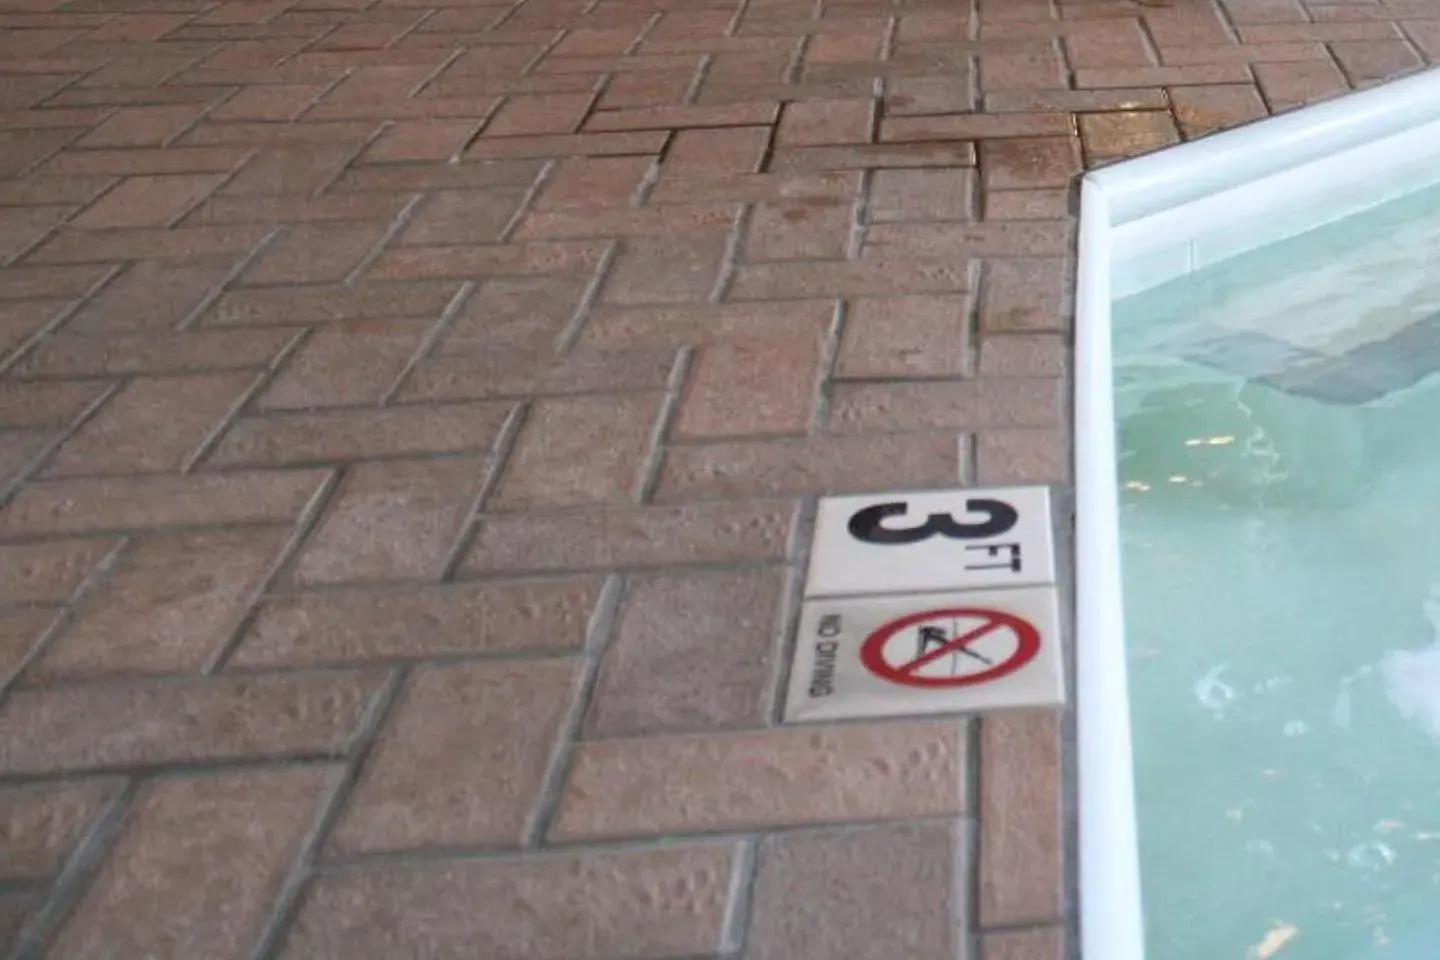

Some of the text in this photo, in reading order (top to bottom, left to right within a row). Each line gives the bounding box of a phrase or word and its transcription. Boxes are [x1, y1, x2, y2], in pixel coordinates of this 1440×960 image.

[847, 498, 1021, 573] 3 FT
[808, 641, 839, 699] DIVING
